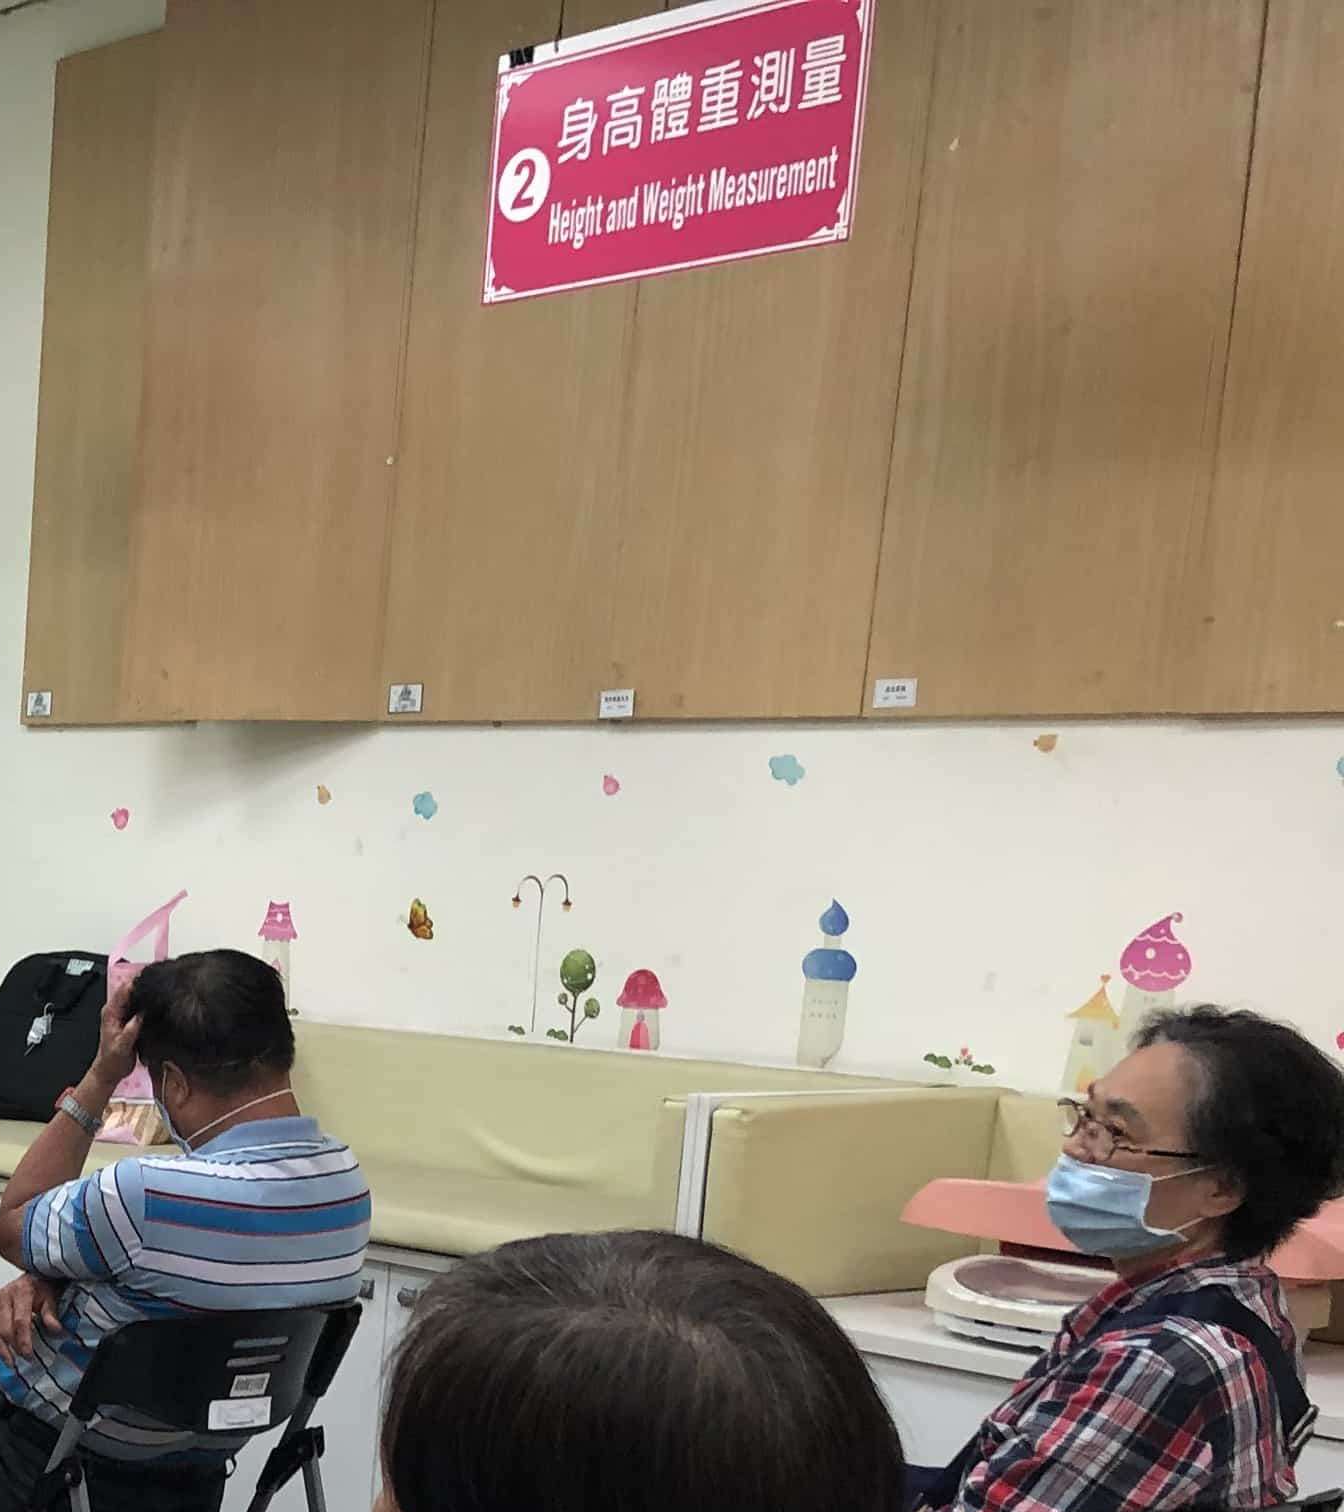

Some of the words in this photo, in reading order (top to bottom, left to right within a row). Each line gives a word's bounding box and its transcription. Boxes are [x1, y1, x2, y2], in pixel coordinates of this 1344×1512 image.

[556, 33, 847, 164] 身高體重測量
[547, 192, 605, 251] Height
[606, 183, 639, 233] and
[641, 173, 705, 231] Weight
[710, 145, 839, 213] Measurement
